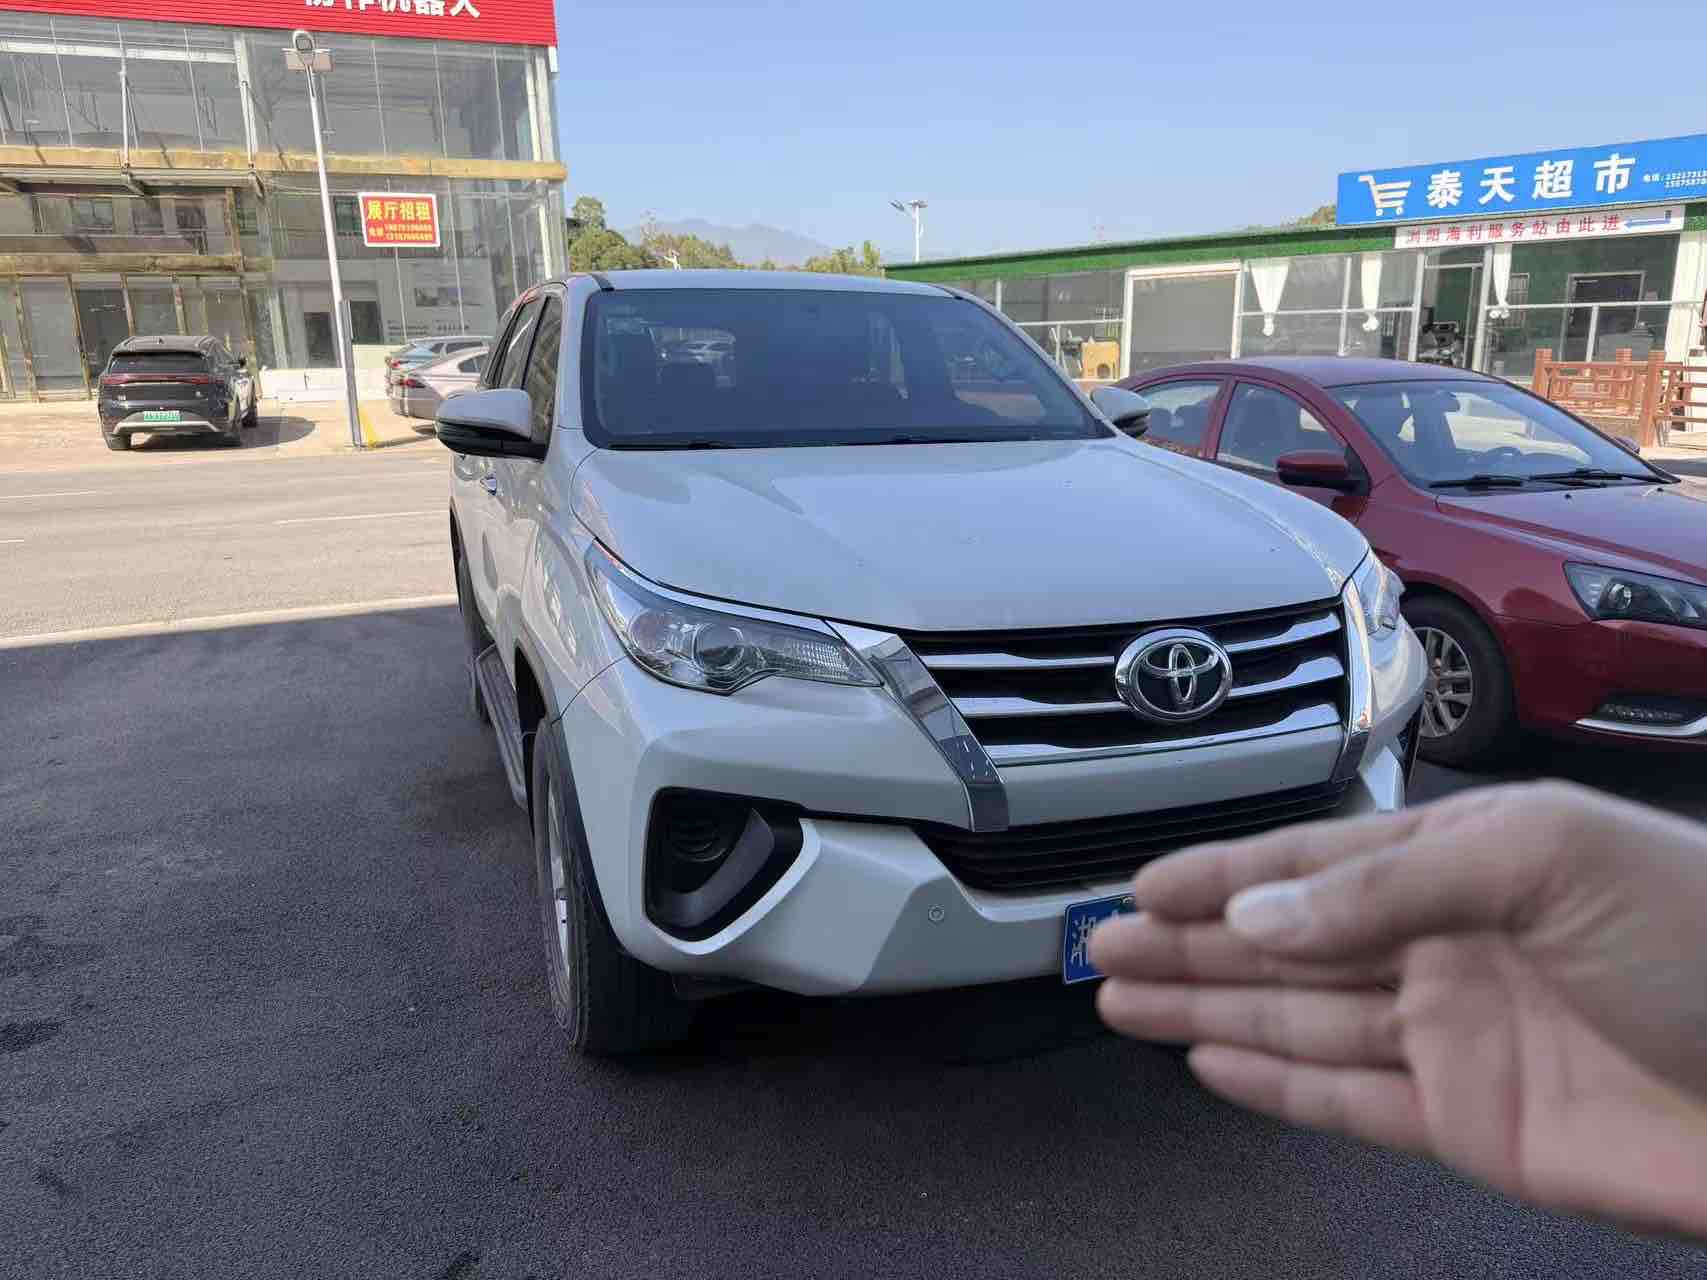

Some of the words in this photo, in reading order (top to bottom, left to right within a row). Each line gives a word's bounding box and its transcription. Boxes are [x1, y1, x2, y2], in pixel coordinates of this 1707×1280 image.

[1426, 153, 1636, 209] 泰天超市
[367, 199, 432, 221] 展厅招租
